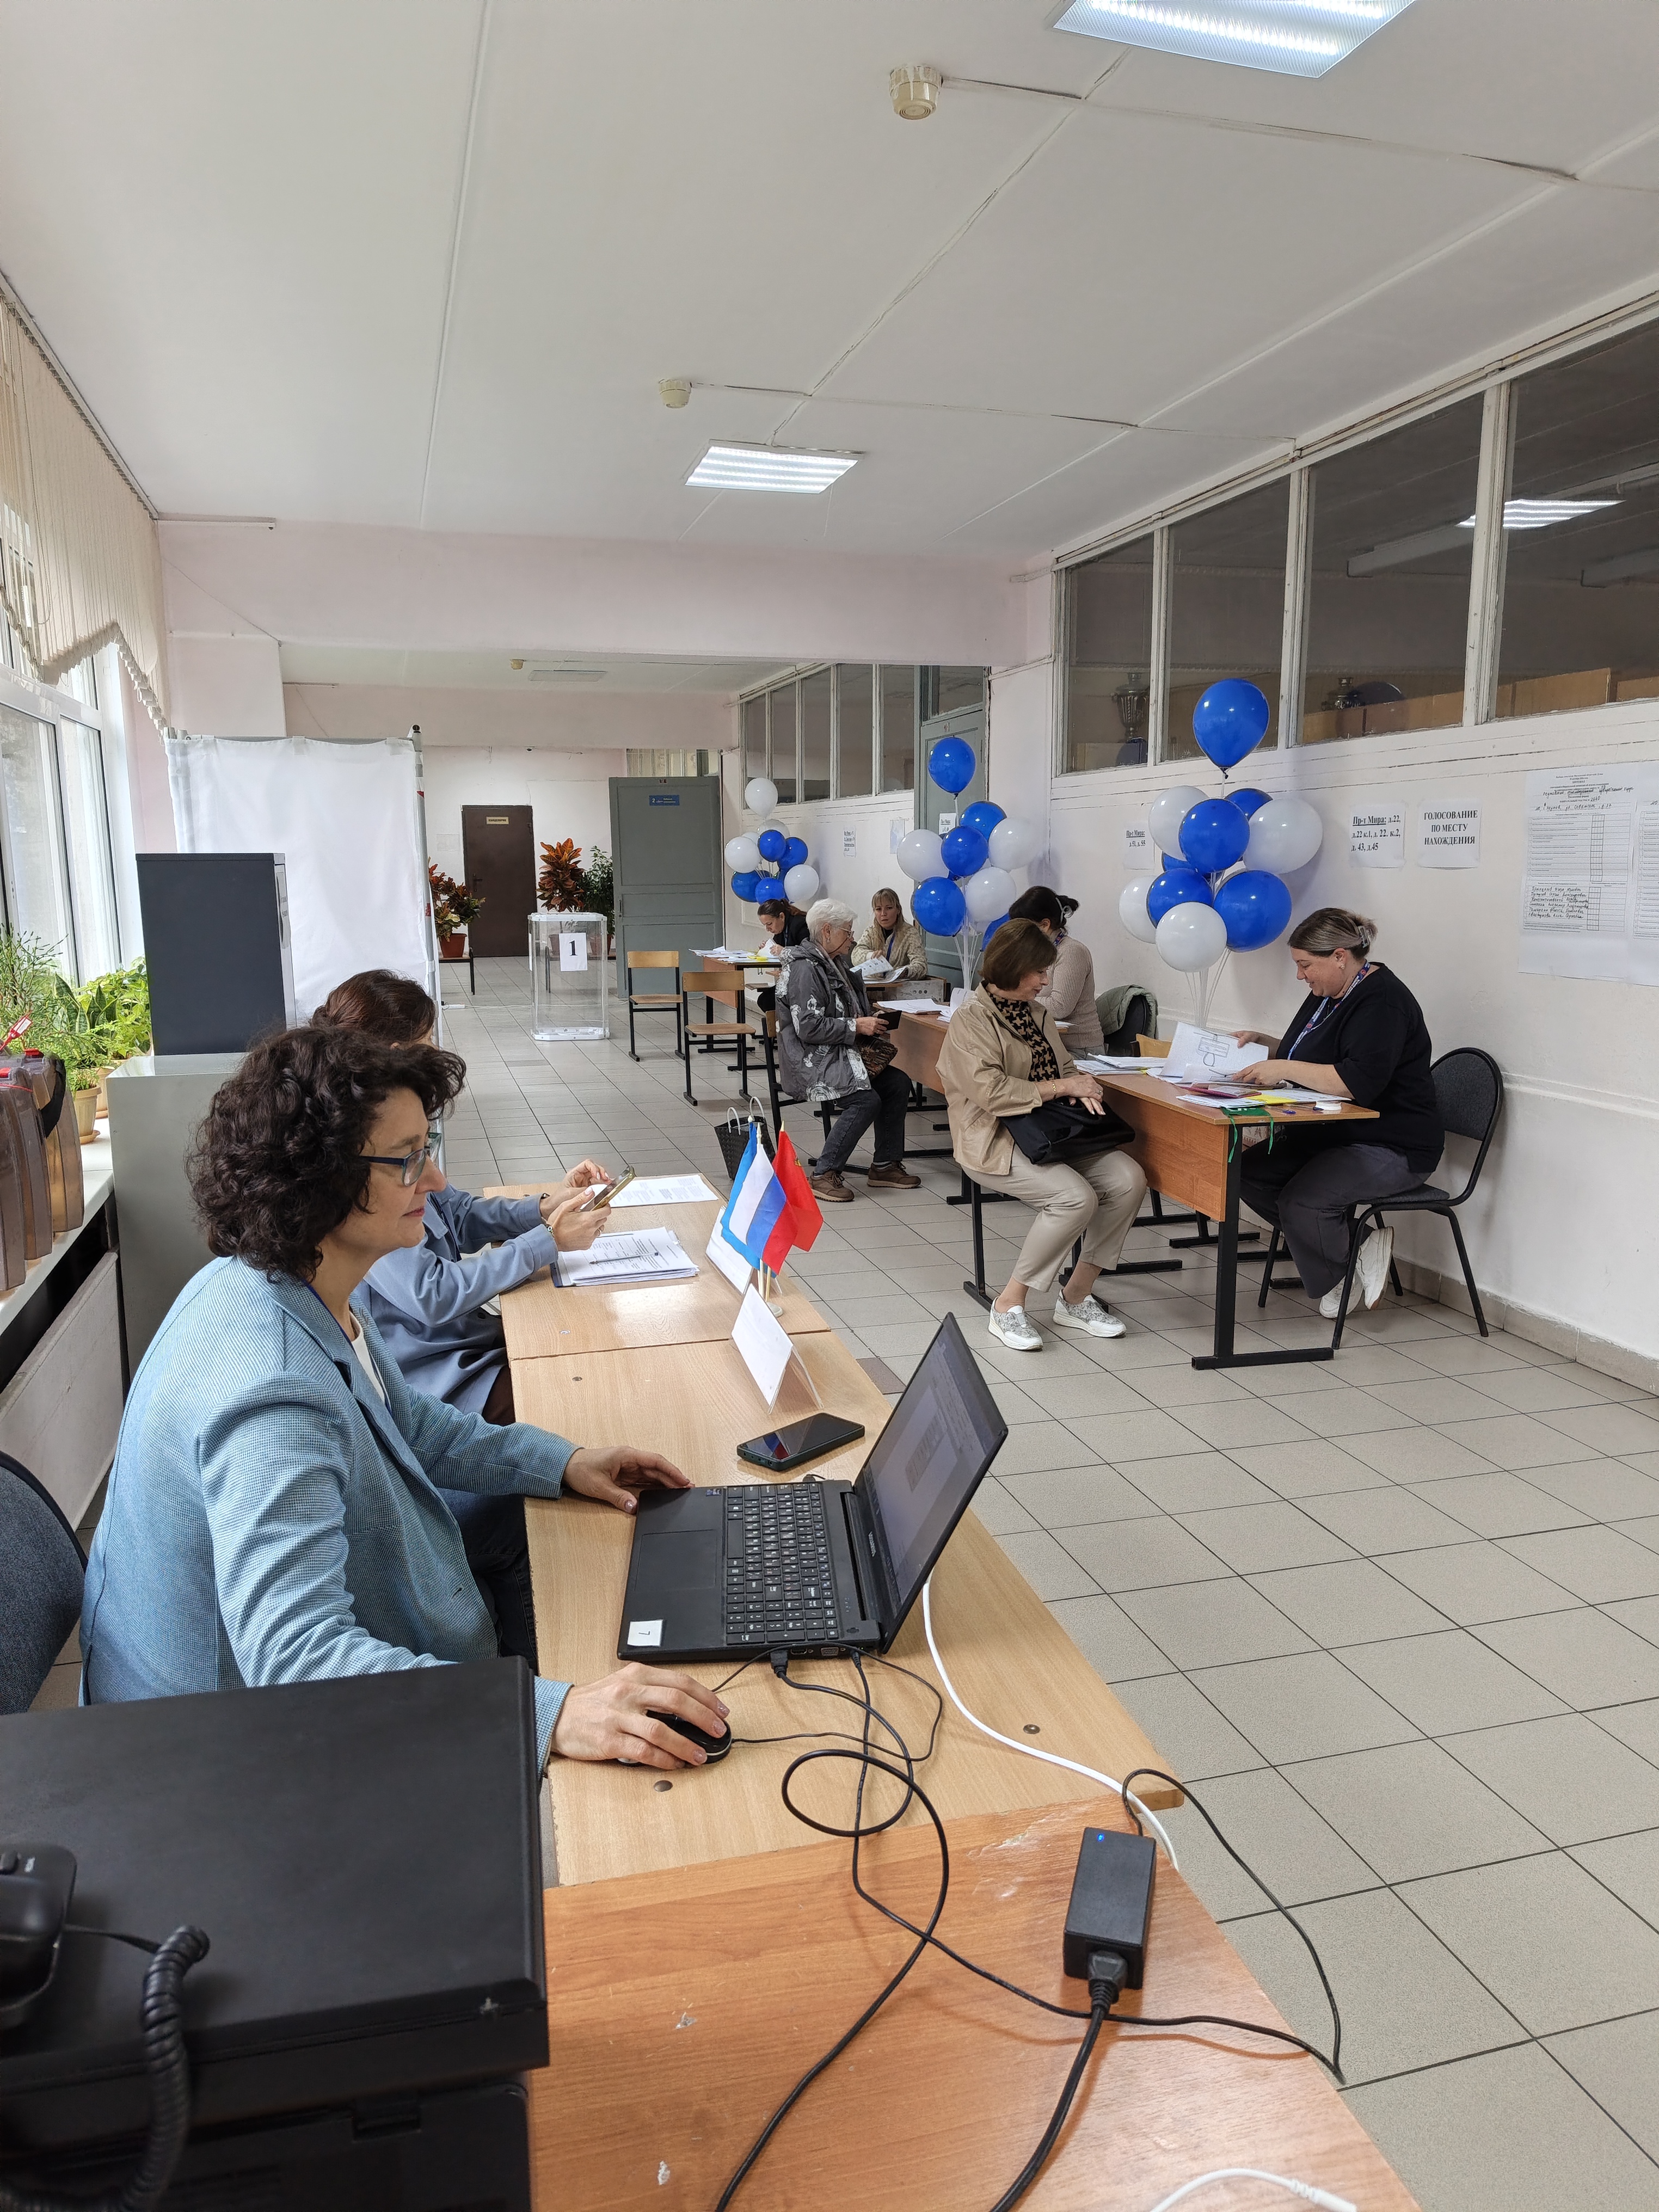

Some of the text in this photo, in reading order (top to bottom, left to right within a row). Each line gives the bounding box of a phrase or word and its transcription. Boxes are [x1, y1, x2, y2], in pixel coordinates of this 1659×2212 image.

[1424, 810, 1478, 820] ГОЛОСОВАНИЕ
[1353, 816, 1367, 825] Пр-т
[1368, 816, 1386, 825] Мира:
[1431, 824, 1468, 833] ПО МЕСТУ
[1424, 836, 1475, 846] НАХОЖДЕНИЯ
[569, 940, 578, 956] 1
